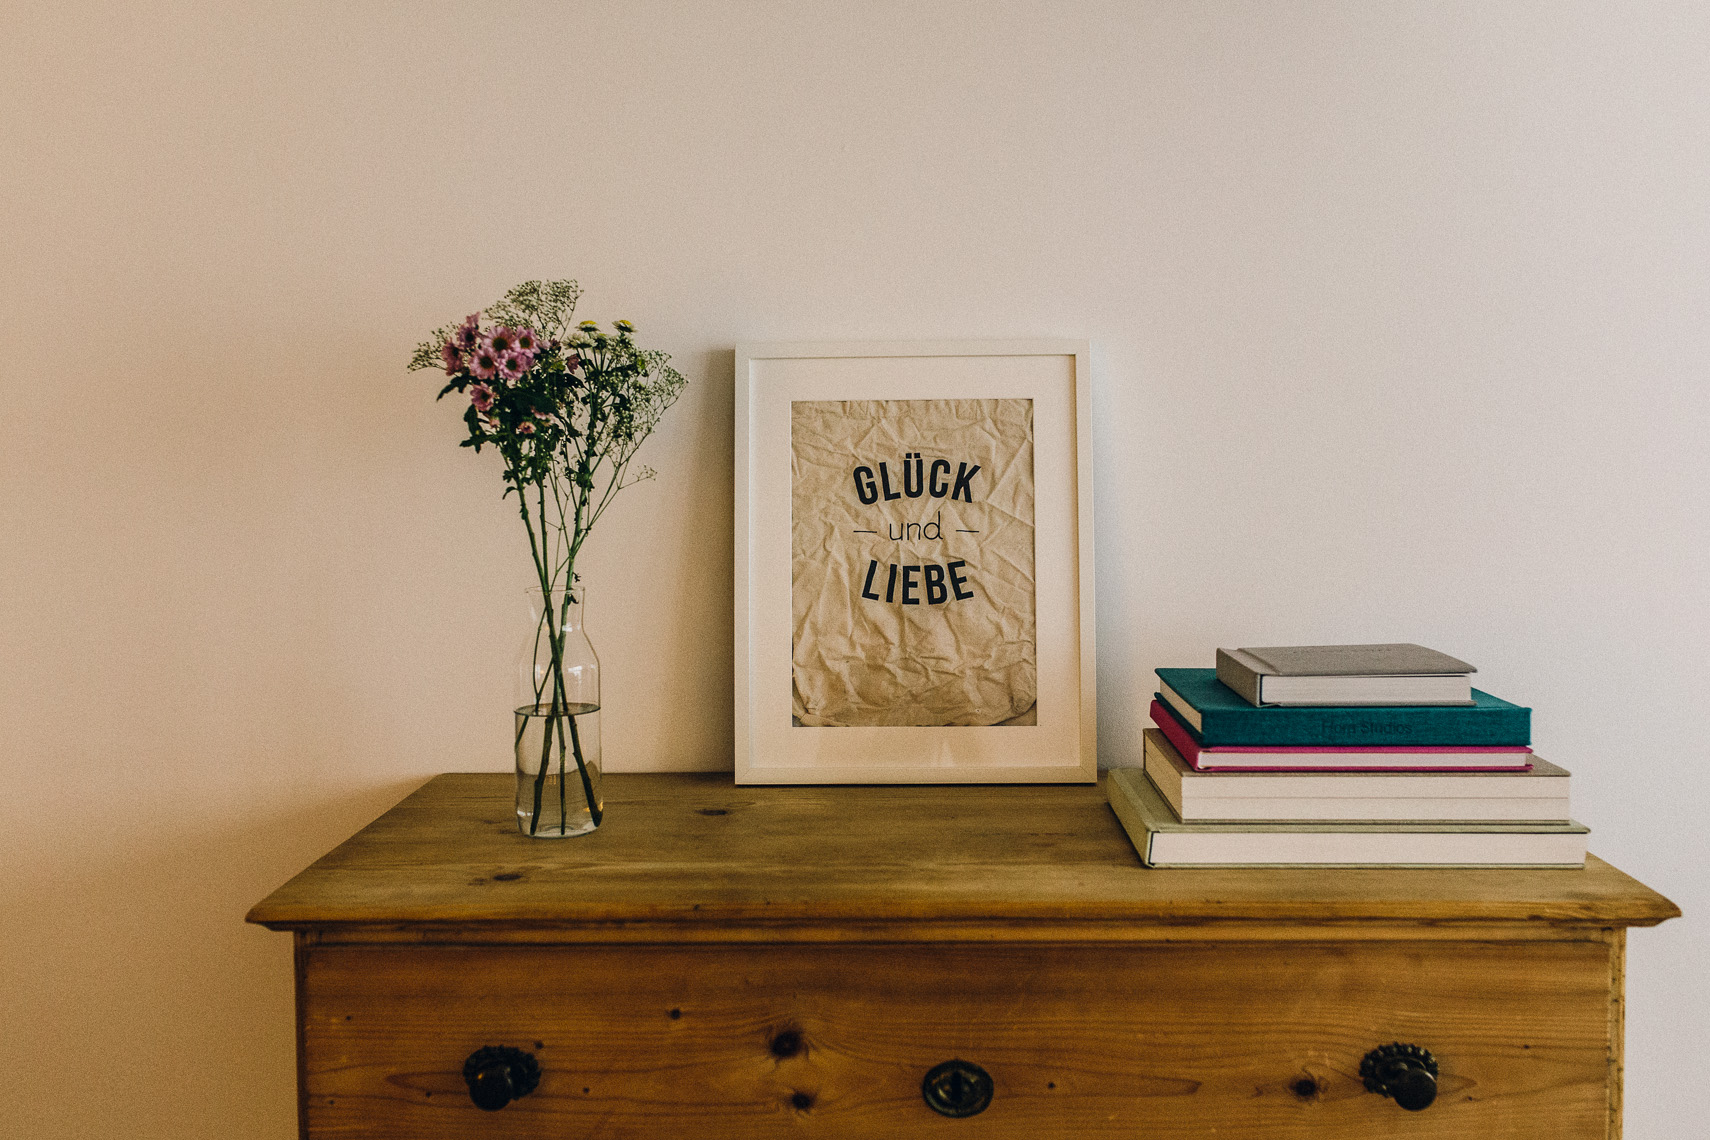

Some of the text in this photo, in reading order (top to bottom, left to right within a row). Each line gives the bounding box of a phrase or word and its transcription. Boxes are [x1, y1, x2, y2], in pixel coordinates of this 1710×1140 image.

[853, 453, 981, 505] GLÜCK
[889, 511, 943, 541] und
[861, 560, 974, 605] LIEBE
[1360, 720, 1413, 734] Studios
